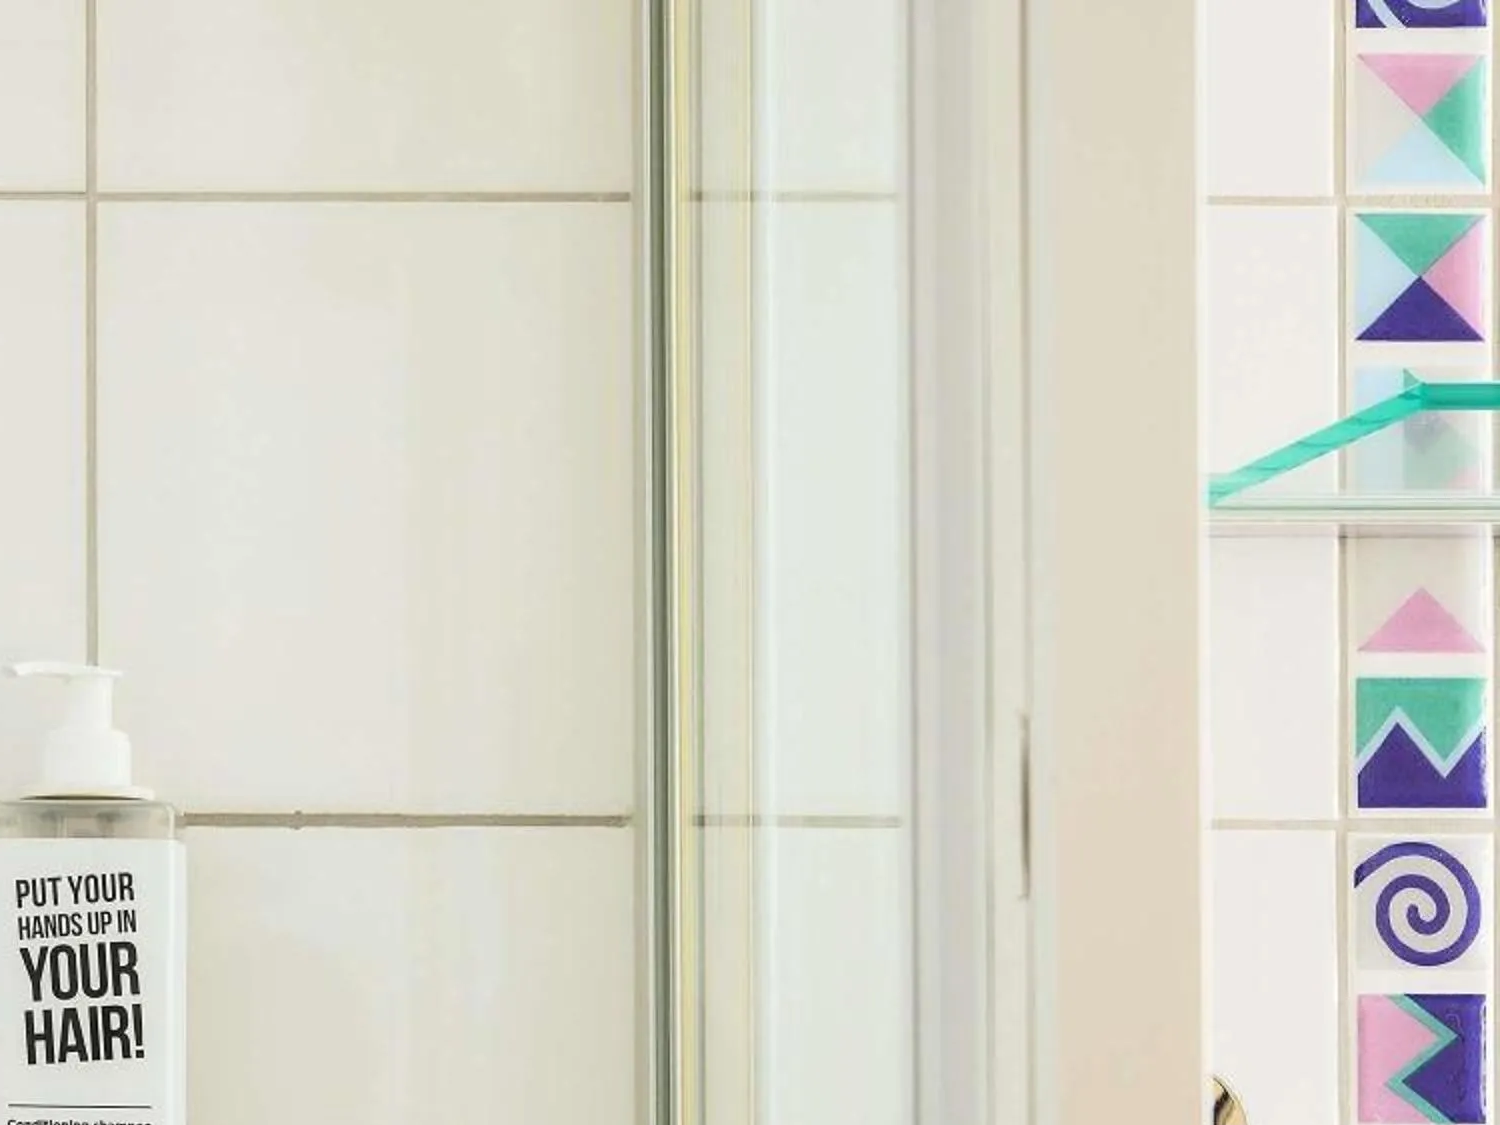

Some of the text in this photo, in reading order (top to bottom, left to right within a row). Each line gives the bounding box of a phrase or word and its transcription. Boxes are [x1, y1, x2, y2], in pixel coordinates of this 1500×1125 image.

[15, 872, 135, 909] PUT YOUR
[18, 909, 137, 940] HANDS UP IN
[19, 941, 141, 1002] YOUR
[24, 1003, 145, 1065] HAIR!
